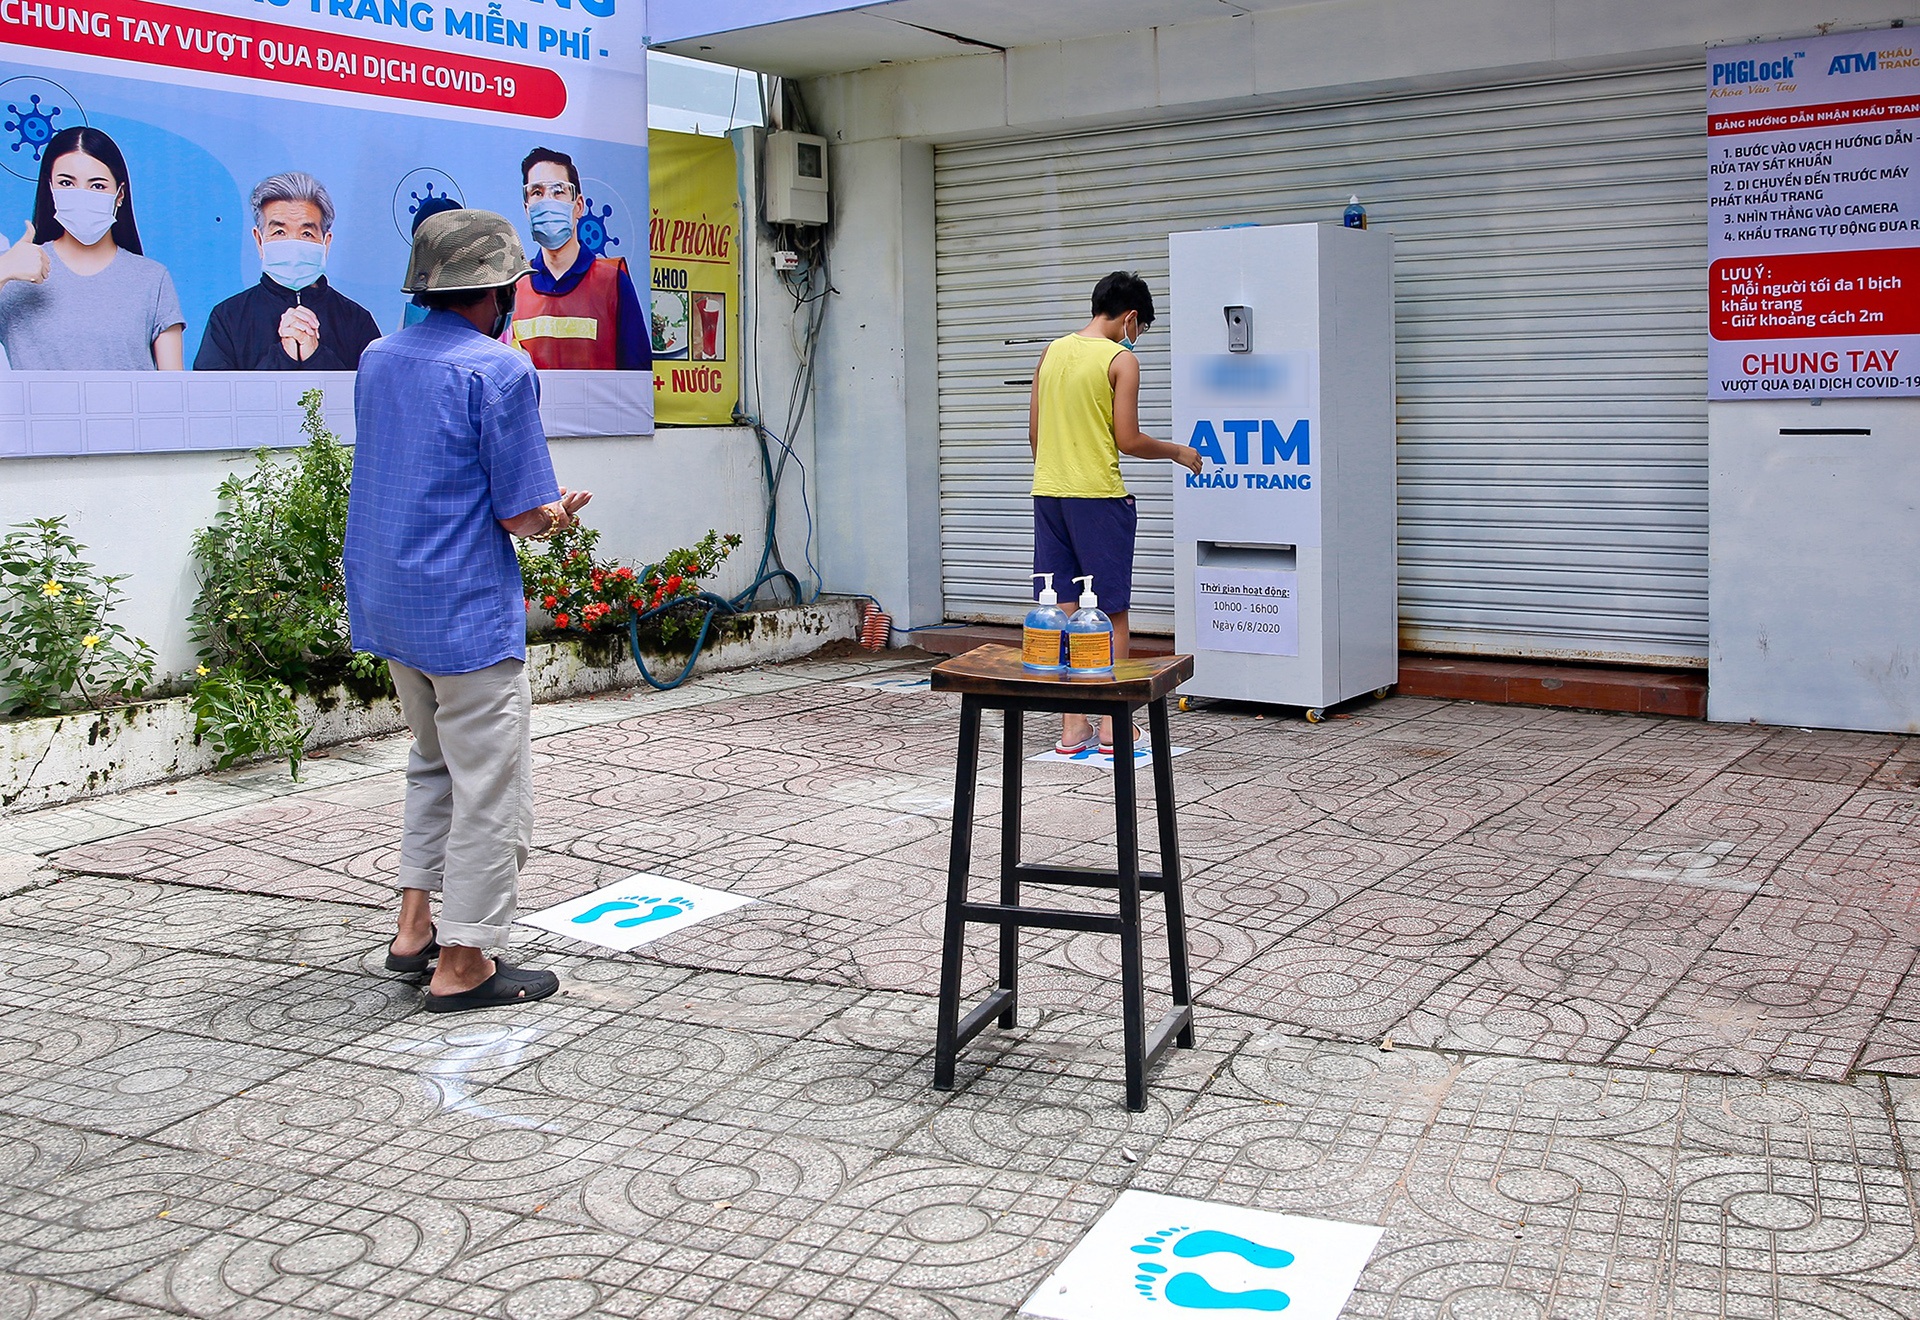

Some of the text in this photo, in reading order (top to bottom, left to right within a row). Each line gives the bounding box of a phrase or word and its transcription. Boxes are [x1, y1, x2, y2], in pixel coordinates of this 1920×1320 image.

[445, 2, 527, 49] MIỄN
[539, 27, 592, 60] PHÍ
[0, 0, 516, 98] CHUNG TAY VƯỢT QUA ĐẠI DỊCH COVID-19
[1827, 51, 1877, 76] ATM
[1879, 58, 1920, 70] TRANG
[1774, 81, 1797, 93] Tay
[1715, 118, 1746, 131] BẢNG
[1748, 115, 1787, 127] HƯỚNG
[1817, 108, 1850, 121] NHẬN
[1888, 103, 1920, 114] TRAN
[1723, 148, 1732, 158] 1.
[1735, 143, 1769, 157] BƯỚC
[1771, 141, 1796, 154] VÀO
[1799, 139, 1832, 154] VẠCH
[1835, 134, 1882, 149] HƯỚNG
[1885, 129, 1913, 144] DẪN
[1710, 161, 1736, 174] RỬA
[1738, 162, 1761, 172] TAY
[1763, 157, 1785, 170] SÁT
[1724, 181, 1734, 191] 2.
[1737, 180, 1749, 190] DI
[1804, 171, 1830, 186] ĐẾN
[1833, 168, 1878, 183] TRƯỚC
[1880, 167, 1910, 179] MÁY
[1711, 193, 1742, 207] PHÁT
[1781, 189, 1824, 201] TRANG
[1724, 213, 1734, 223] 3.
[1737, 209, 1768, 223] NHÌN
[1815, 204, 1841, 217] VÀO
[1844, 203, 1899, 216] CAMERA
[670, 213, 732, 258] PHÒNG
[1724, 220, 1920, 241] 4. KHẨU TRANG TỰ ĐỘNG ĐƯA R
[1721, 267, 1752, 280] LƯU
[1754, 263, 1765, 279] Ý
[1731, 280, 1759, 296] Mỗi
[1762, 280, 1807, 297] người
[1810, 277, 1831, 292] tối
[1834, 278, 1854, 291] đa
[1856, 276, 1864, 290] 1
[1868, 276, 1901, 292] bịch
[1721, 296, 1803, 312] khẩu trang
[1731, 314, 1757, 327] Giữ
[1759, 311, 1816, 327] khoảng
[1819, 310, 1855, 323] cách
[1859, 309, 1884, 322] 2m
[1742, 349, 1899, 376] CHUNG TAY
[672, 365, 722, 393] NƯỚC
[1721, 376, 1920, 394] VƯỢT QUA ĐẠI DỊCH COVID-19
[1188, 420, 1310, 465] ATM
[1186, 468, 1312, 490] KHẨU TRANG
[1200, 582, 1290, 598] Thời gian hoạt động:
[1214, 601, 1242, 612] 10h00
[1250, 603, 1279, 614] 16h00
[1212, 620, 1280, 634] Ngày 6/8/2020
